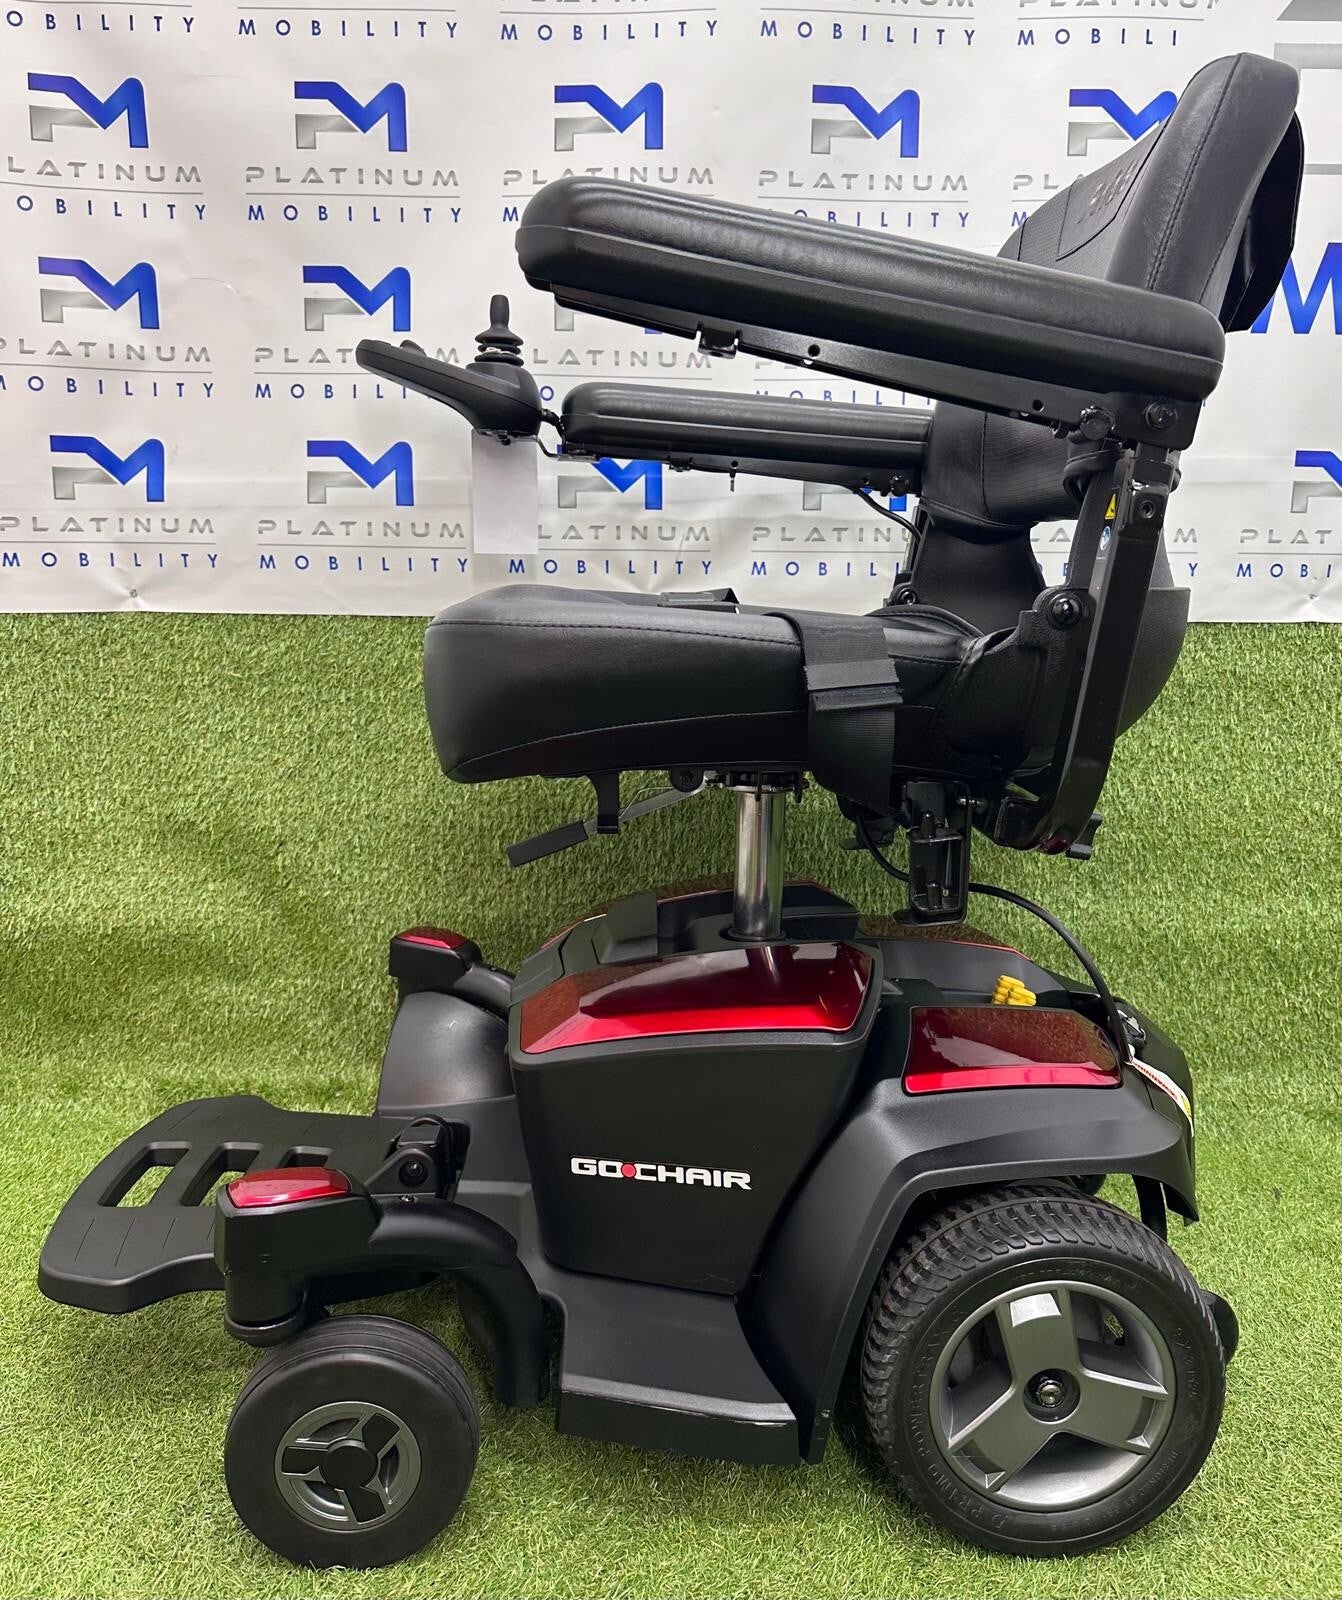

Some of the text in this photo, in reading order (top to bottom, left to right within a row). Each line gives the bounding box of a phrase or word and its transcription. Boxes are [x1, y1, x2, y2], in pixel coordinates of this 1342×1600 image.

[6, 10, 194, 33] OBILITY
[238, 19, 458, 38] MOBILITY
[500, 20, 718, 41] MOBILITY
[760, 20, 976, 46] MOBILITY
[1017, 28, 1177, 46] MOBILI
[7, 156, 202, 183] LATINUM
[245, 166, 459, 187] PLATINUM
[758, 170, 968, 191] PLATINUM
[16, 195, 206, 221] OBILITY
[248, 204, 462, 223] MOBILITY
[533, 348, 712, 369] LATINUM
[255, 383, 407, 399] MOBILI
[0, 516, 214, 534] PLATINUM
[258, 519, 464, 539] PLATINUM
[538, 524, 710, 542] LATINUM
[752, 526, 908, 543] PLATIN
[2, 552, 218, 568] MOBILITY
[260, 554, 468, 572] MOBILITY
[509, 559, 712, 575] MOBILITY
[751, 561, 899, 576] MOBILI
